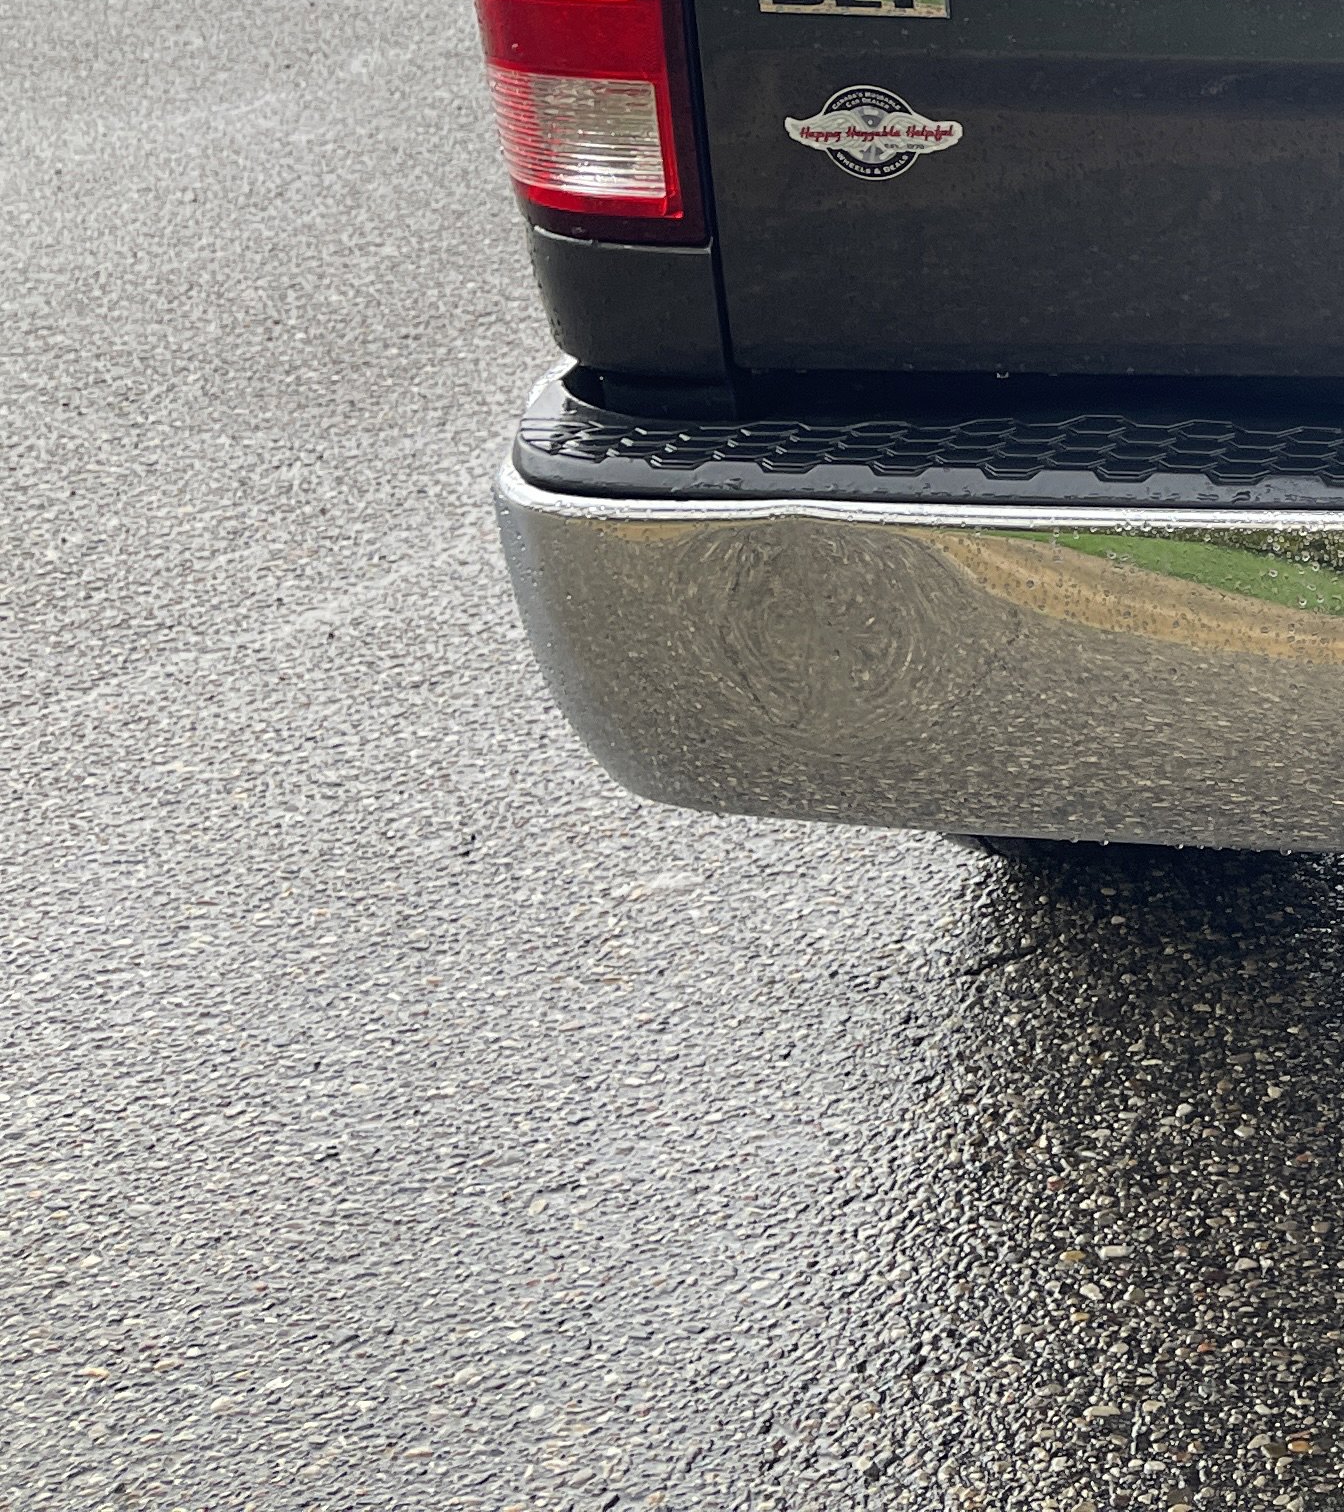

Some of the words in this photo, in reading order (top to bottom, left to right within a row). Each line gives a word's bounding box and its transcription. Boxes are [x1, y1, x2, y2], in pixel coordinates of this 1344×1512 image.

[800, 126, 842, 142] Happy
[906, 125, 954, 142] Helpful
[883, 155, 909, 173] DEALS
